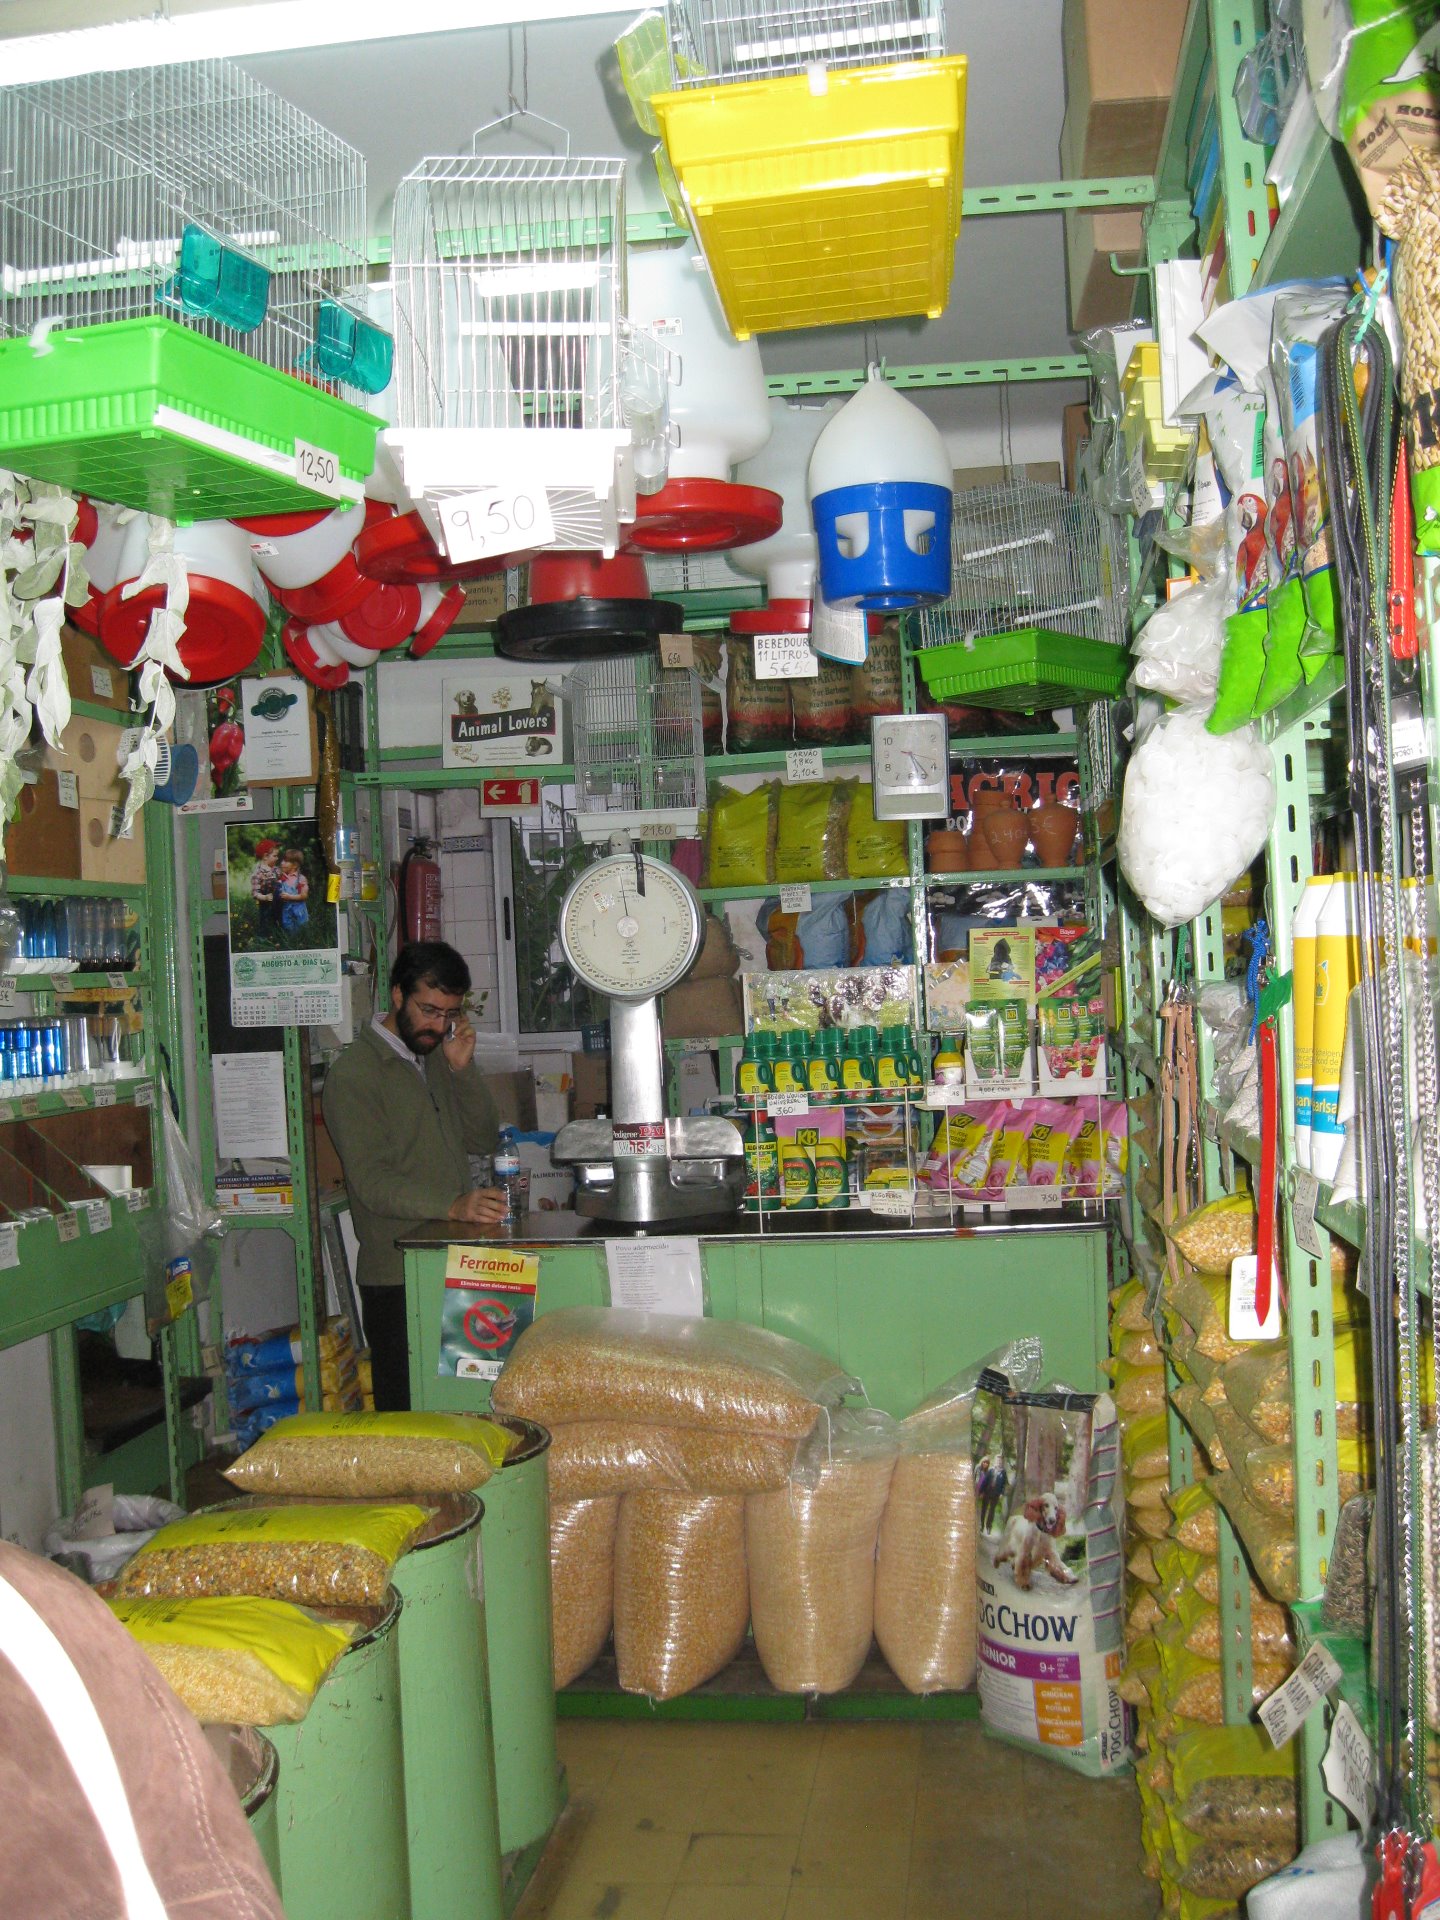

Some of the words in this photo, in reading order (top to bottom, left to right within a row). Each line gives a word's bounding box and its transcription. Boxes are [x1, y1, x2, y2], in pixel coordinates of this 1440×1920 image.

[300, 449, 334, 484] 12,50
[451, 495, 535, 548] 9,50
[771, 649, 809, 661] LITROS
[458, 717, 502, 738] Animal
[508, 715, 548, 731] Lovers
[883, 736, 893, 745] 10
[261, 960, 292, 968] AUGUSTO
[302, 958, 318, 966] DIAS
[798, 1129, 818, 1145] KB
[1031, 1125, 1051, 1140] KB
[617, 1140, 665, 1156] Whiskas
[460, 1254, 525, 1274] Ferramol
[997, 1604, 1078, 1643] CHOW
[1039, 1660, 1056, 1674] 9+
